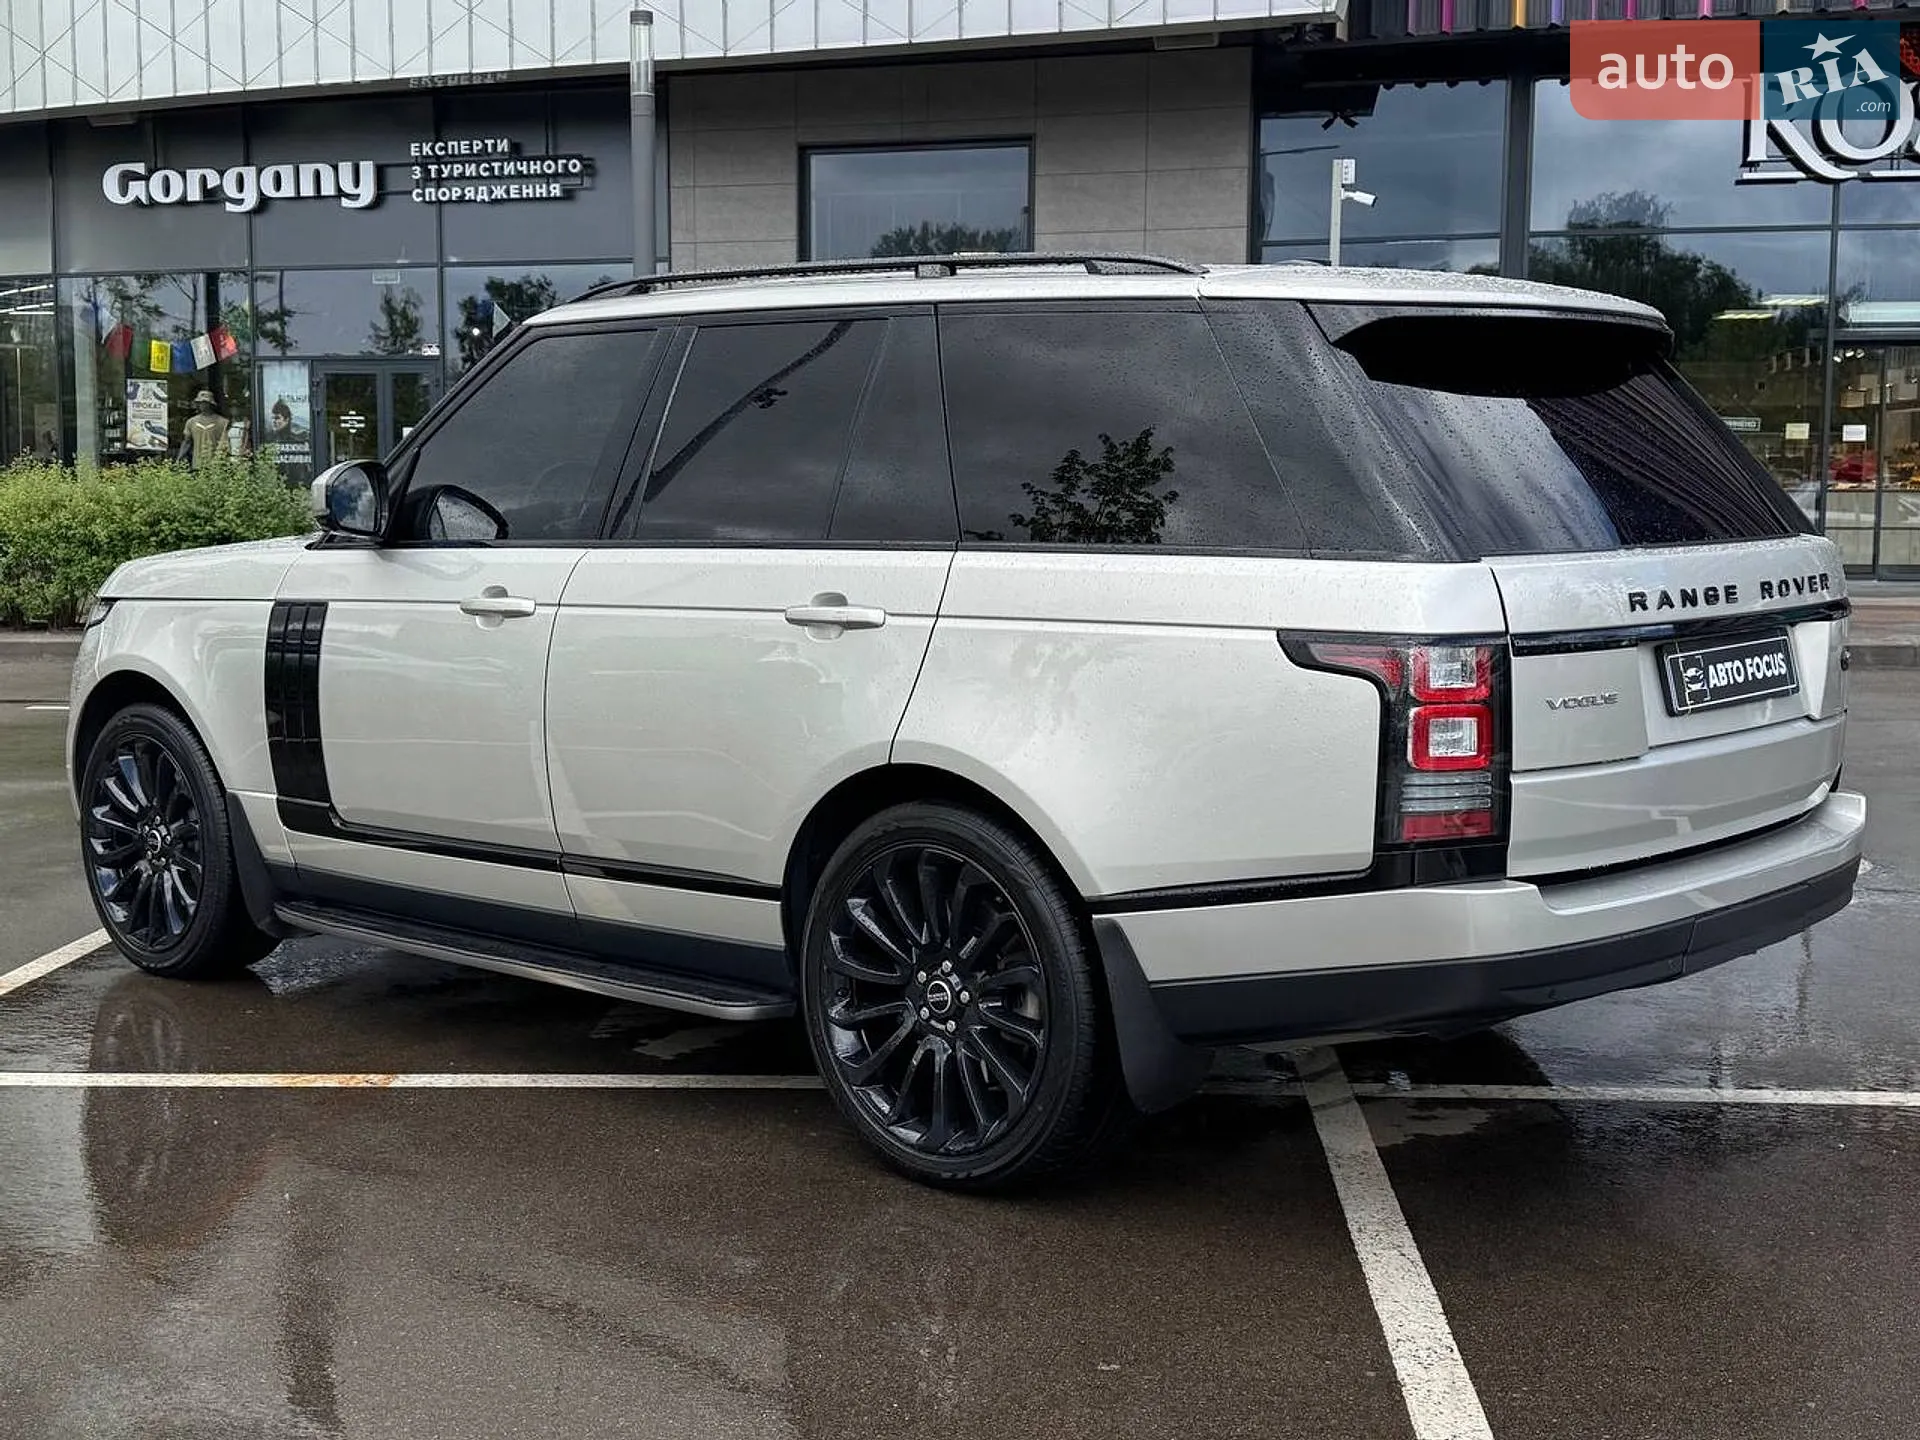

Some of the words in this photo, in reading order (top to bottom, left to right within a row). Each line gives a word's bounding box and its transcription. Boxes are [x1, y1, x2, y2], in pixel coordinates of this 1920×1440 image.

[1747, 72, 1920, 180] RO
[410, 138, 509, 157] ЕКСПЕРТИ
[411, 166, 421, 180] З
[428, 158, 582, 179] ТУРИСТИЧНОГО
[102, 160, 377, 213] Gorgany
[412, 183, 561, 202] СПОРЯДЖЕННЯ
[1628, 584, 1739, 613] RANGE
[1759, 572, 1830, 600] ROVER
[1708, 664, 1744, 688] АВТО
[1747, 652, 1787, 682] FOCUS
[1546, 691, 1619, 711] VOGUE
